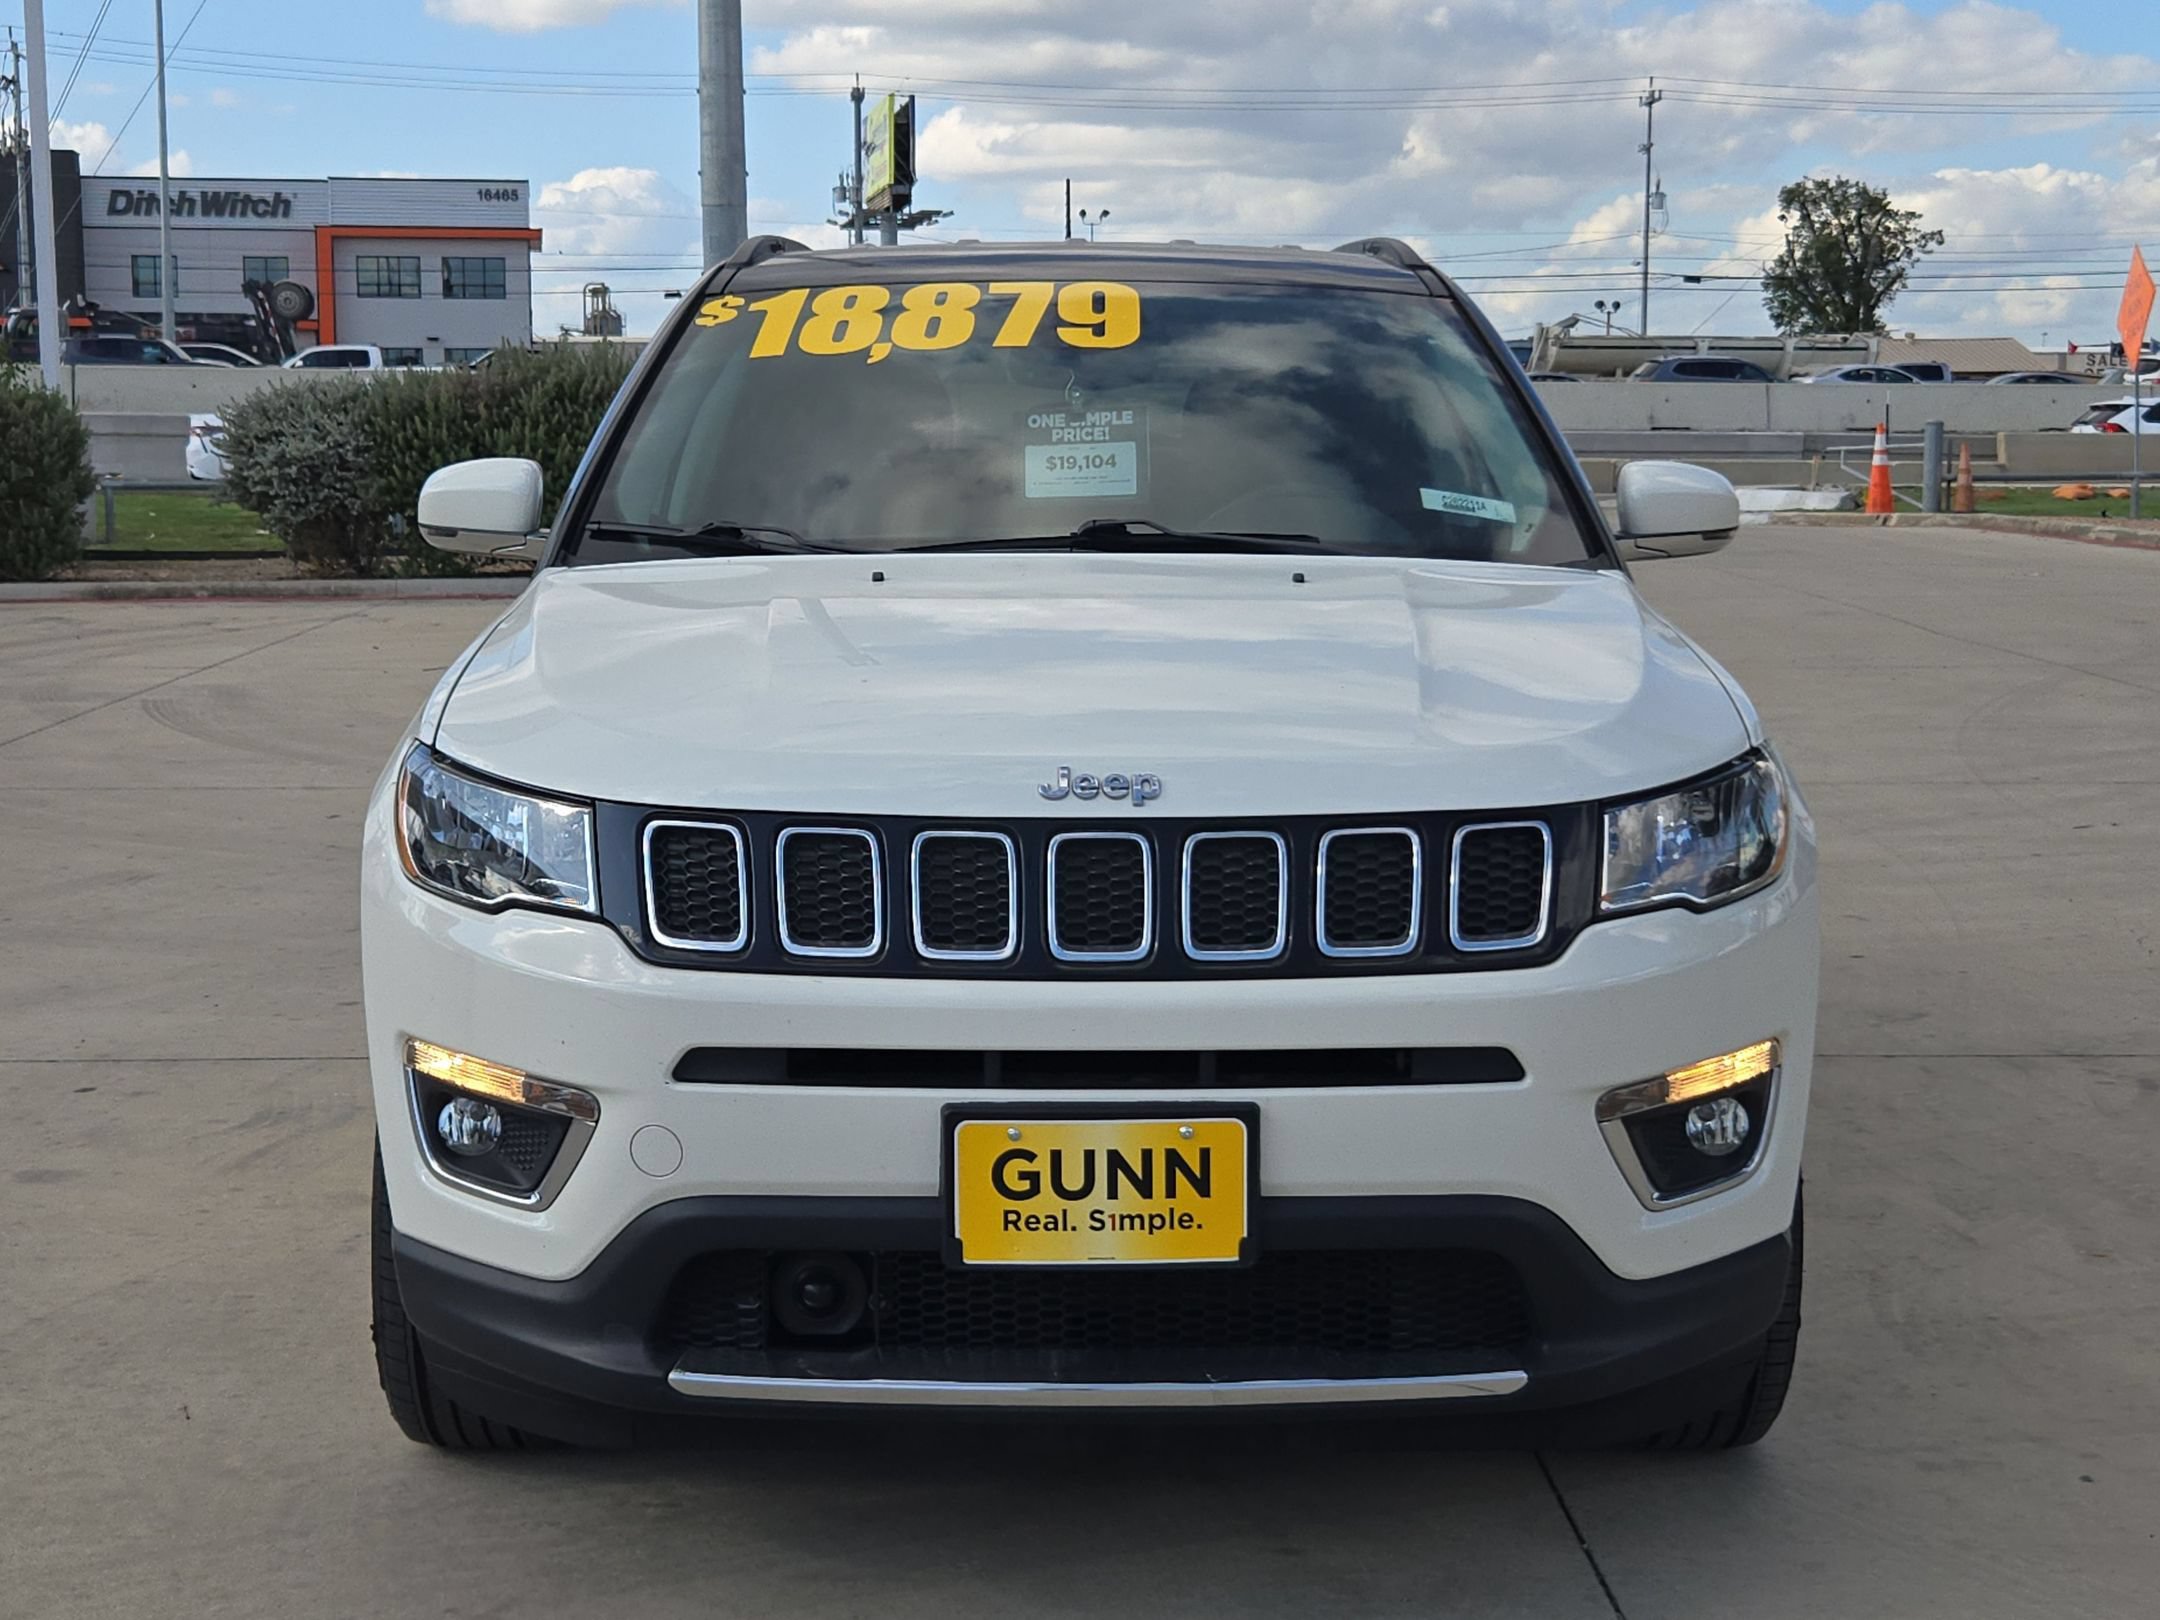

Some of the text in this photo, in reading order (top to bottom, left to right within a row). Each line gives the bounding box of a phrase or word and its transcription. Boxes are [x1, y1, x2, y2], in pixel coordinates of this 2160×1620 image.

[200, 191, 292, 219] Witch
[477, 188, 519, 202] 16465
[694, 281, 1141, 365] $18,879
[1027, 410, 1134, 429] ONE MPLE
[1051, 426, 1110, 442] PRICE!
[1045, 453, 1117, 472] $19,104
[1038, 766, 1162, 807] Jeep
[991, 1147, 1211, 1201] GUNN
[1002, 1208, 1078, 1232] Real.
